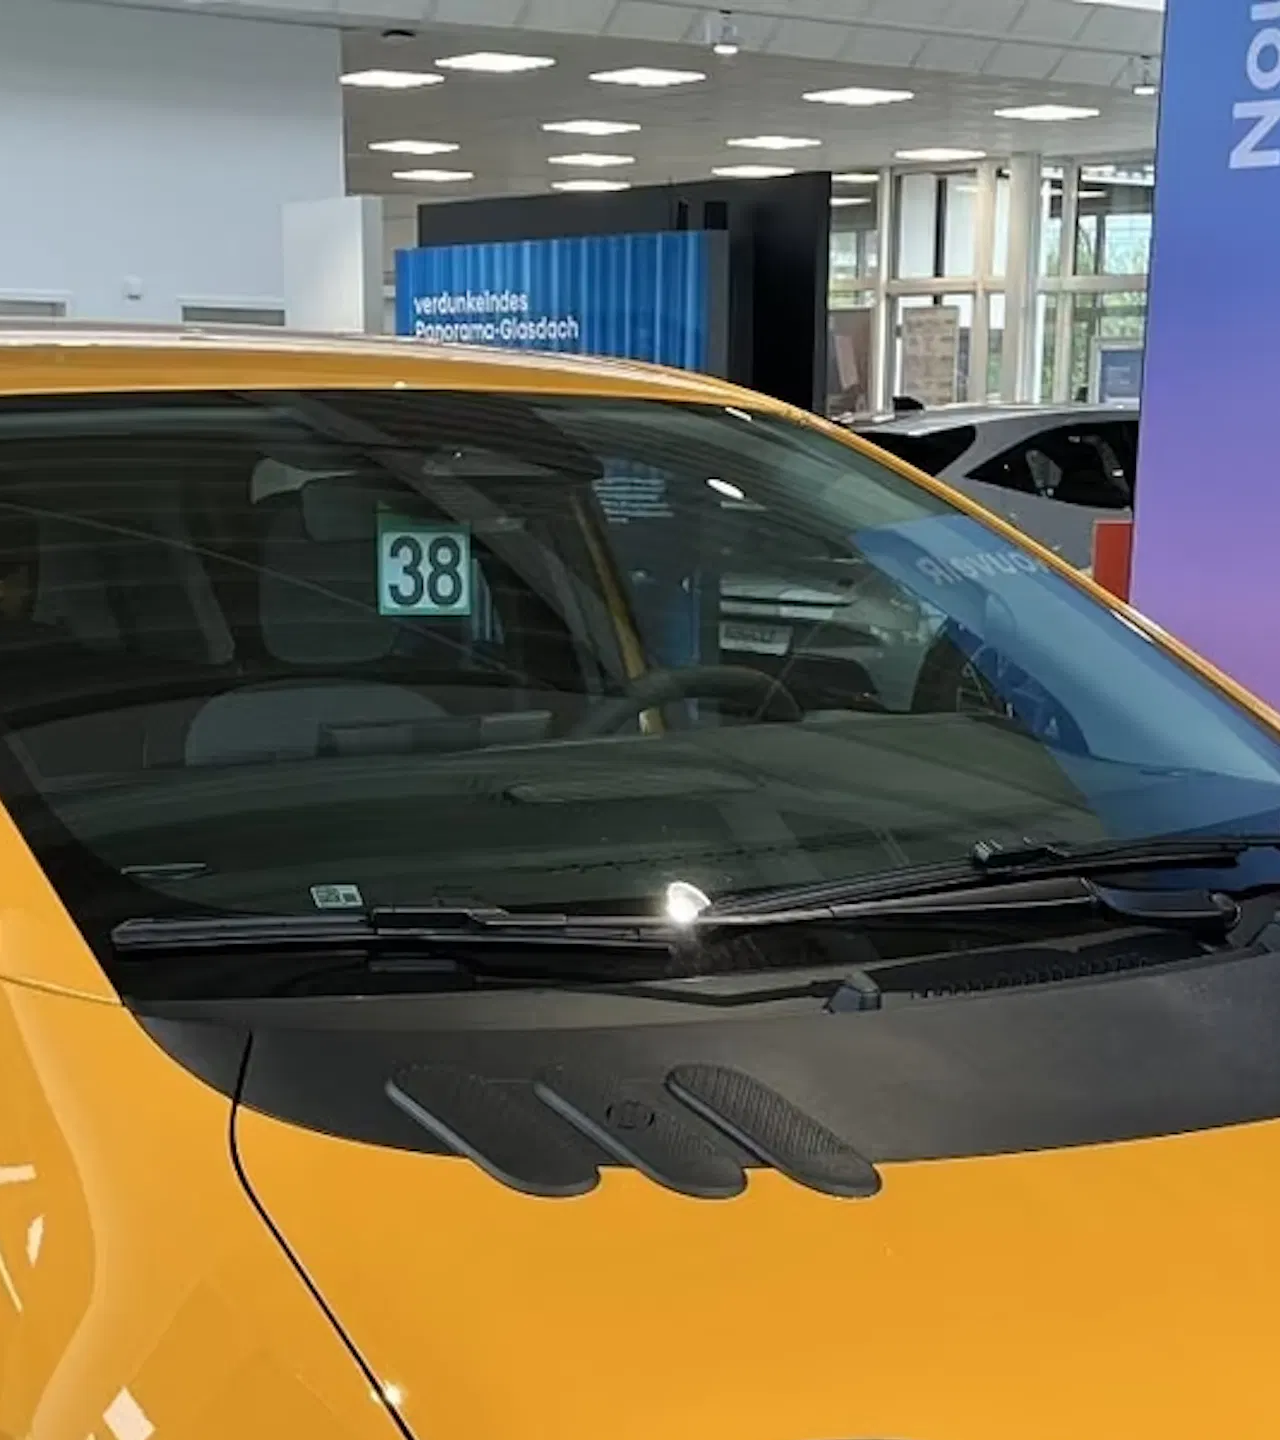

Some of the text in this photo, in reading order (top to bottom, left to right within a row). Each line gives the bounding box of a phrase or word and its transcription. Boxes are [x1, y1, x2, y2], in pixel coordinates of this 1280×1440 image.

[413, 289, 529, 315] verdunkelndes
[416, 315, 579, 342] Panorama-Glasdach
[388, 536, 462, 606] 38
